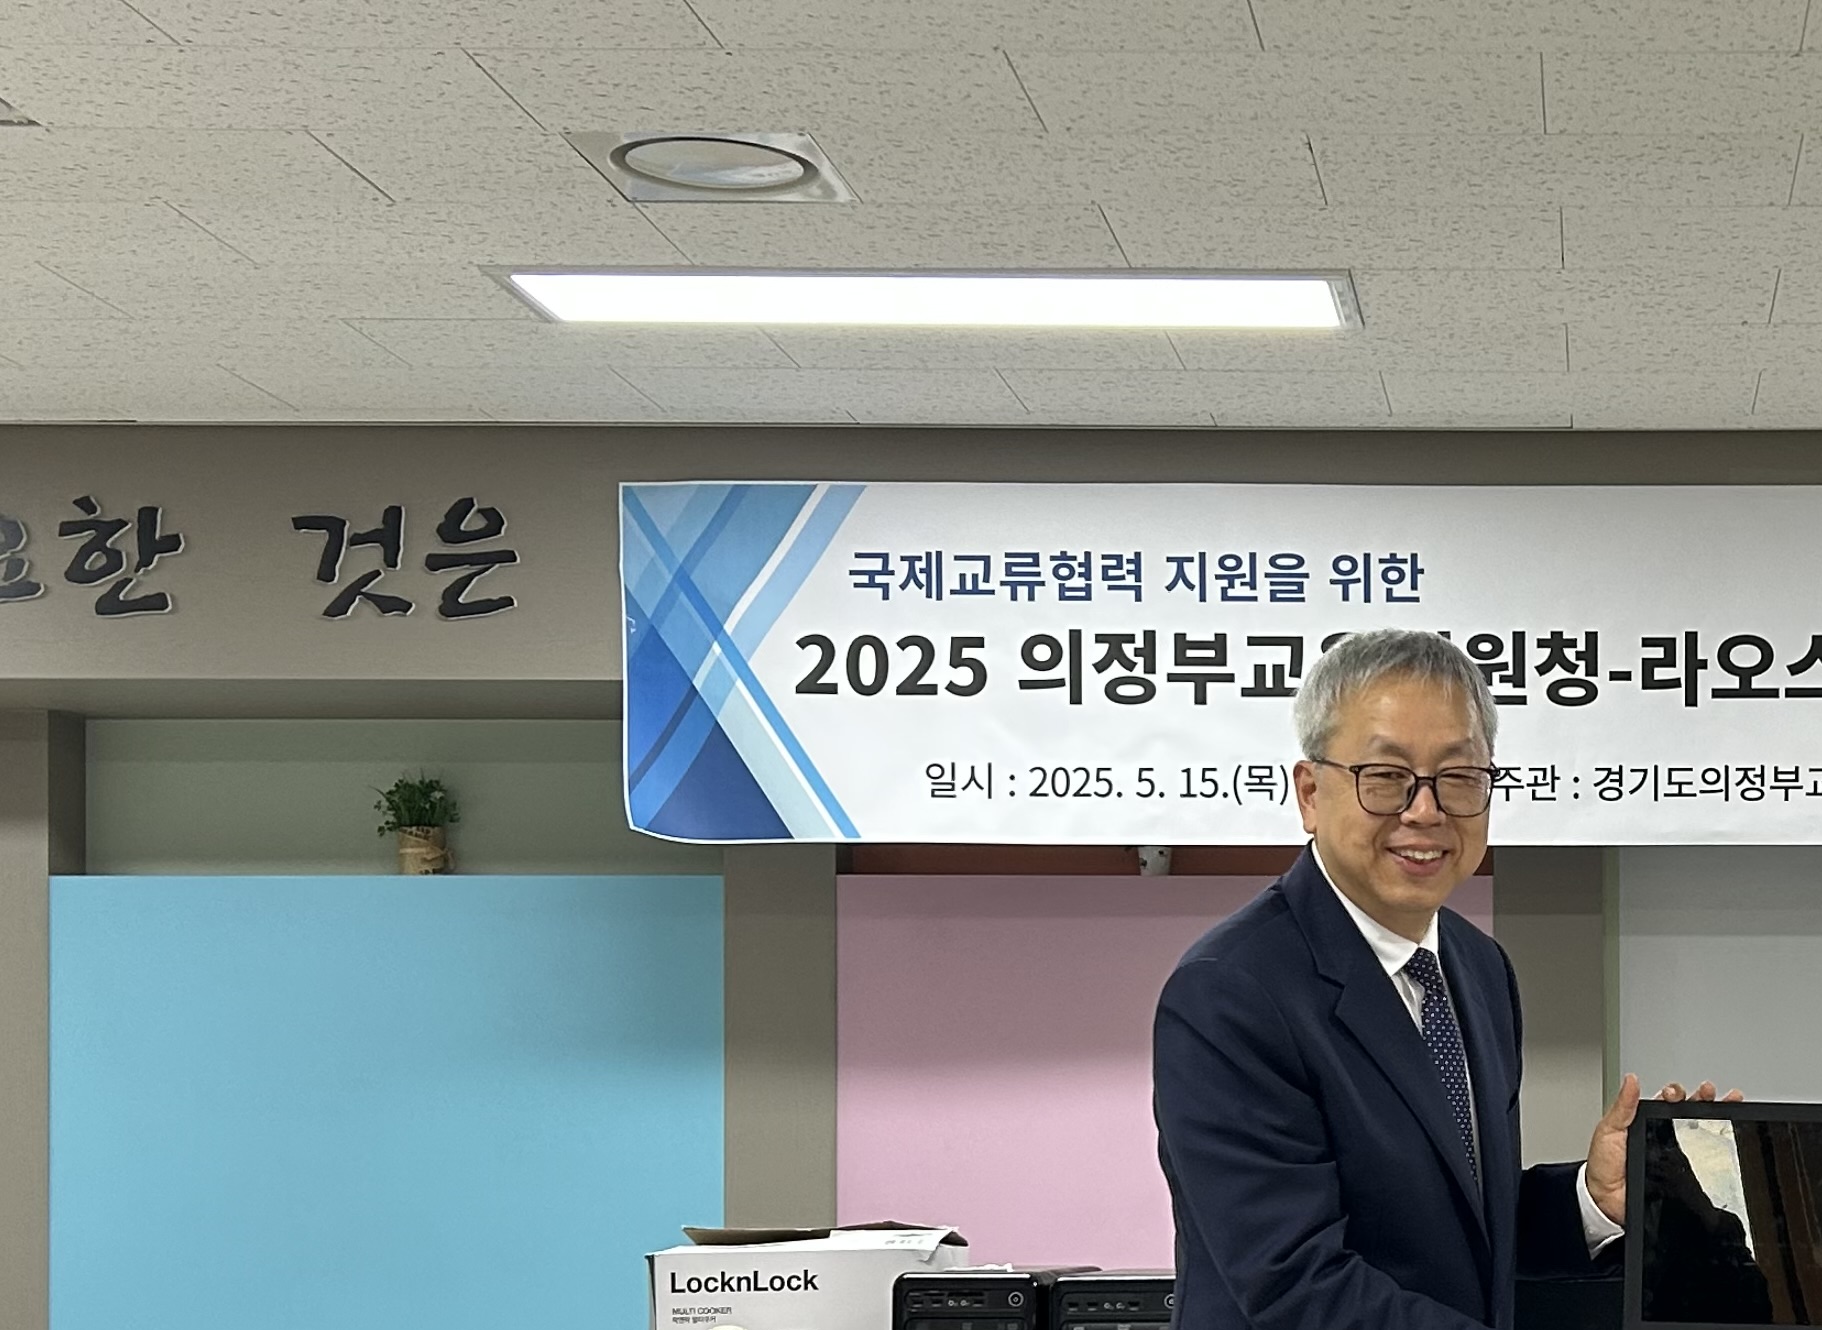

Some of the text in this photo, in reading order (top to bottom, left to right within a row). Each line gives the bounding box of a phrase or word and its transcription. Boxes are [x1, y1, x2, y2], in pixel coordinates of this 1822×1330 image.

[291, 496, 518, 620] 것은
[849, 551, 1424, 603] 국제교류협력 지원을 위한
[795, 633, 988, 698] 2025
[925, 762, 992, 800] 일시
[1029, 766, 1123, 799] 2025.
[1135, 767, 1165, 799] 5.
[1179, 764, 1289, 806] 15.(목)
[1494, 766, 1560, 802] 주관
[670, 1269, 819, 1294] LocknLock
